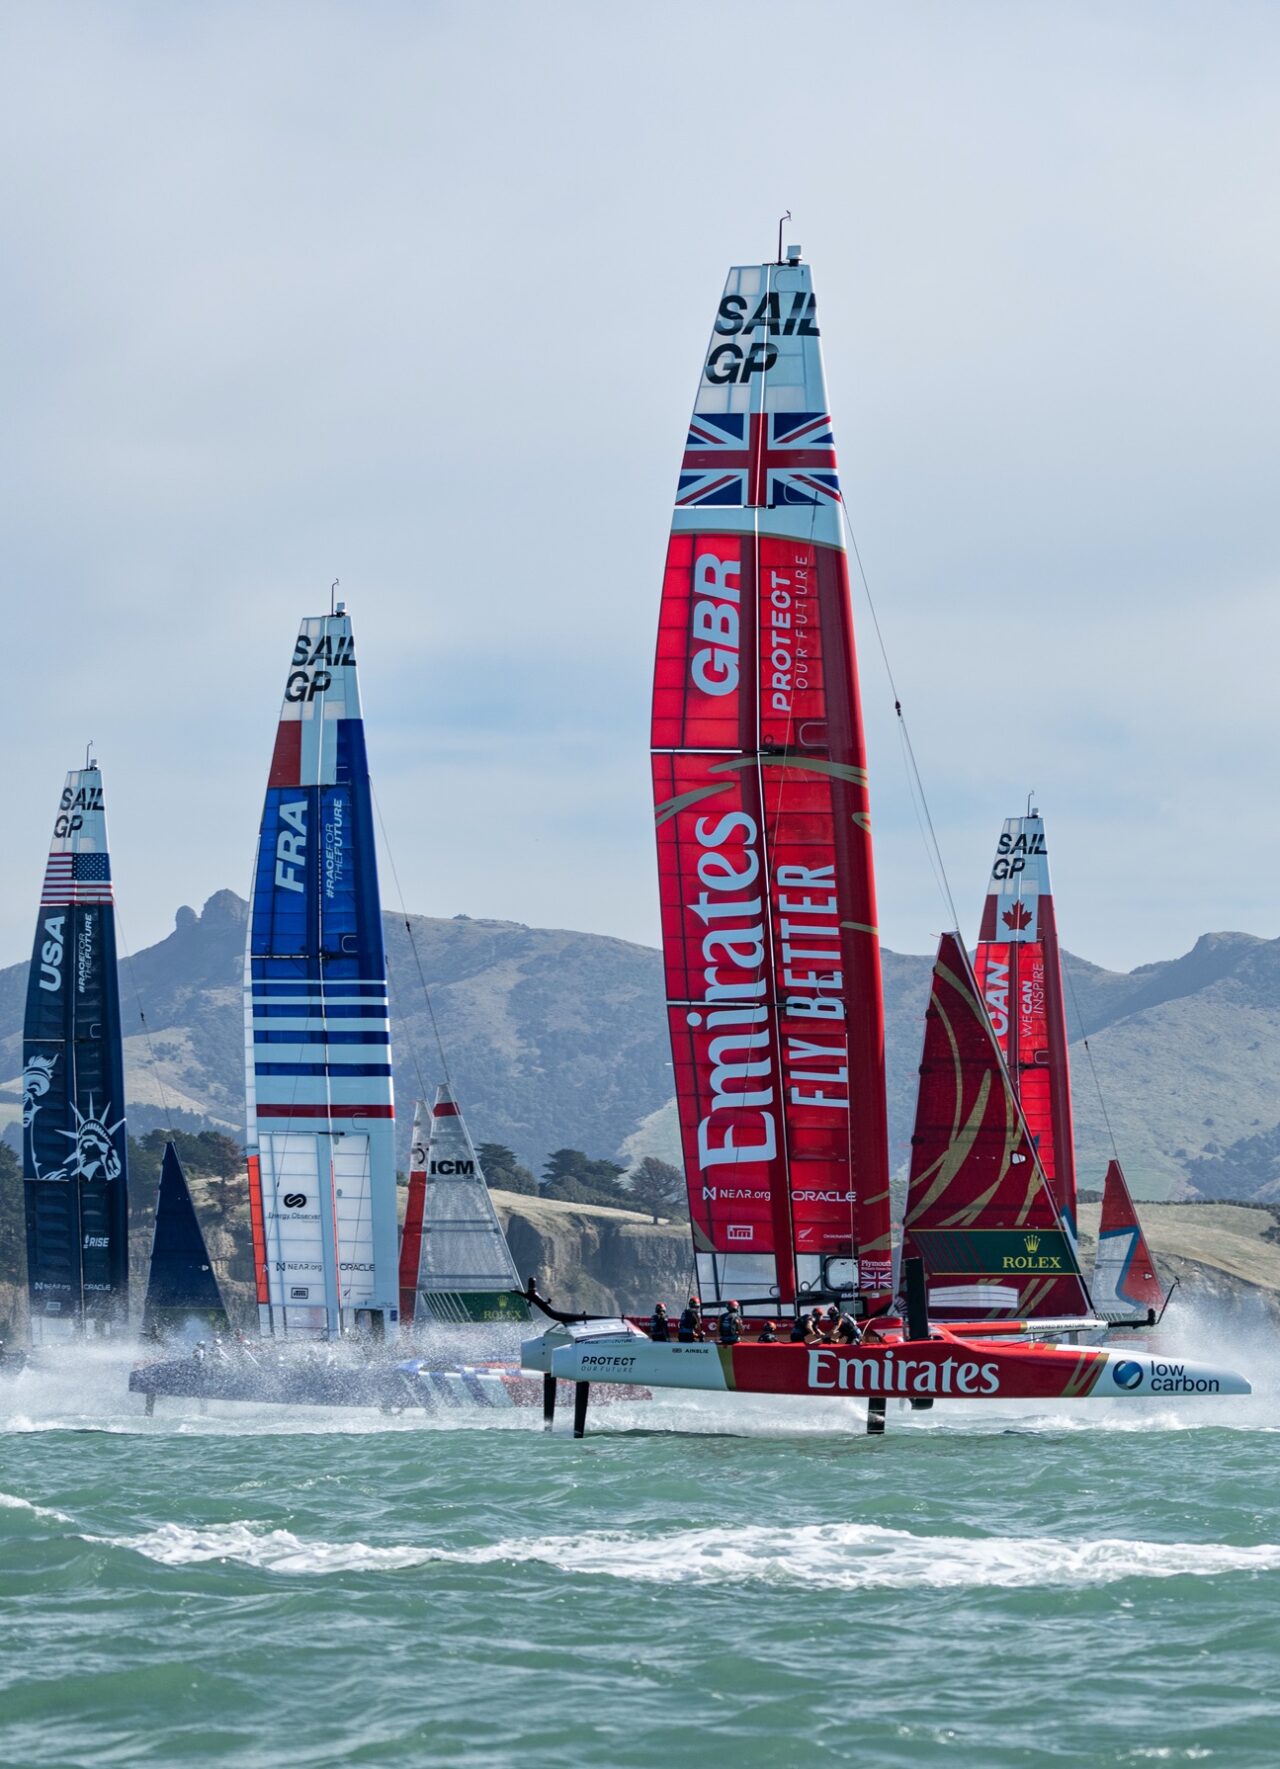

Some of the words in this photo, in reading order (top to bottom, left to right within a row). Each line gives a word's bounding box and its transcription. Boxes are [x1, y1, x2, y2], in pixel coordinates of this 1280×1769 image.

[714, 292, 820, 336] SAIL
[705, 343, 779, 384] GP
[797, 555, 808, 627] FUTURE
[691, 552, 741, 696] GBR
[771, 571, 791, 712] PROTECT
[291, 635, 357, 667] SAIL
[796, 636, 808, 689] OUR
[284, 670, 331, 702] GP
[59, 788, 105, 811] SAIL
[54, 815, 83, 838] GP
[997, 833, 1048, 855] SAIL
[275, 801, 307, 893] FRA
[992, 858, 1025, 880] GP
[39, 915, 65, 992] USA
[777, 864, 846, 1020] BETTER
[687, 811, 777, 1171] Emirates
[985, 961, 1009, 1037] CAN
[1033, 963, 1044, 1014] INSPIRE
[788, 1032, 849, 1108] FLY
[431, 1160, 474, 1175] ICM
[720, 1190, 771, 1201] NEAR.org
[791, 1191, 856, 1202] ORACLE
[89, 1237, 110, 1247] RISE
[340, 1263, 376, 1271] ORACLE
[1003, 1257, 1062, 1269] ROLEX
[581, 1356, 636, 1366] PROTECT
[807, 1349, 1000, 1394] Emirates
[1151, 1361, 1184, 1376] low
[1151, 1371, 1219, 1393] carbon
